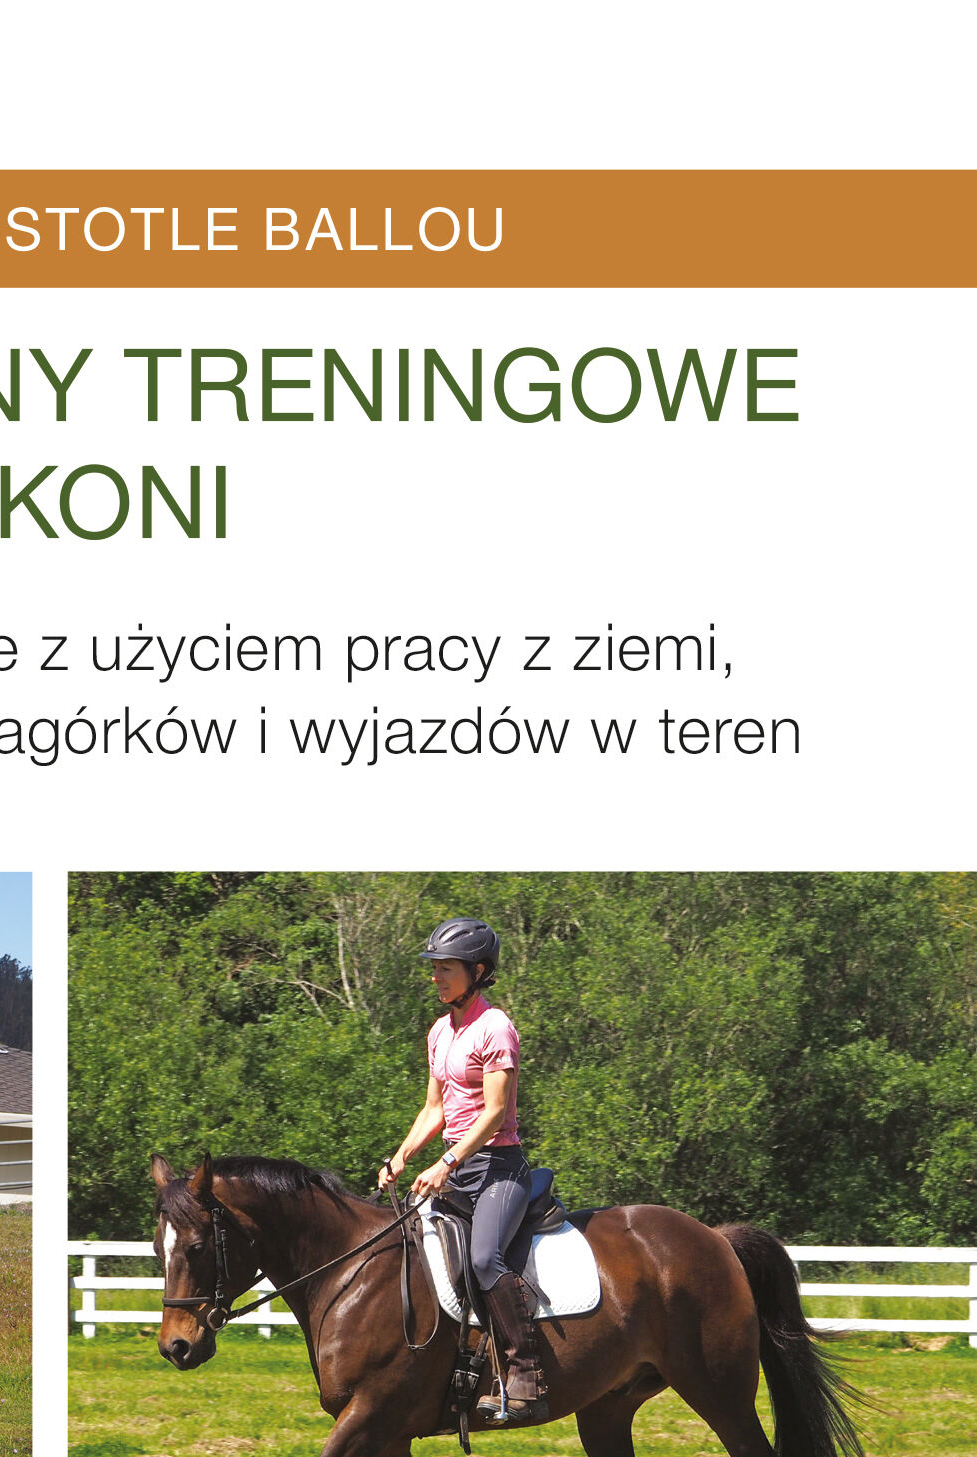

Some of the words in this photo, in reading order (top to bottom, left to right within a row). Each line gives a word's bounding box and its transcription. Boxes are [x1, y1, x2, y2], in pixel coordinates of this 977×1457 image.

[266, 207, 502, 251] BALLOU
[124, 347, 799, 423] TRENINGOWE
[1, 464, 226, 540] KONI
[41, 636, 68, 670] z
[93, 623, 320, 683] użyciem
[348, 636, 501, 683] pracy
[524, 636, 551, 670] z
[574, 623, 731, 678] ziemi,
[260, 706, 266, 754] i
[290, 706, 569, 766] wyjazdów
[591, 719, 636, 753] w
[659, 709, 799, 754] teren
